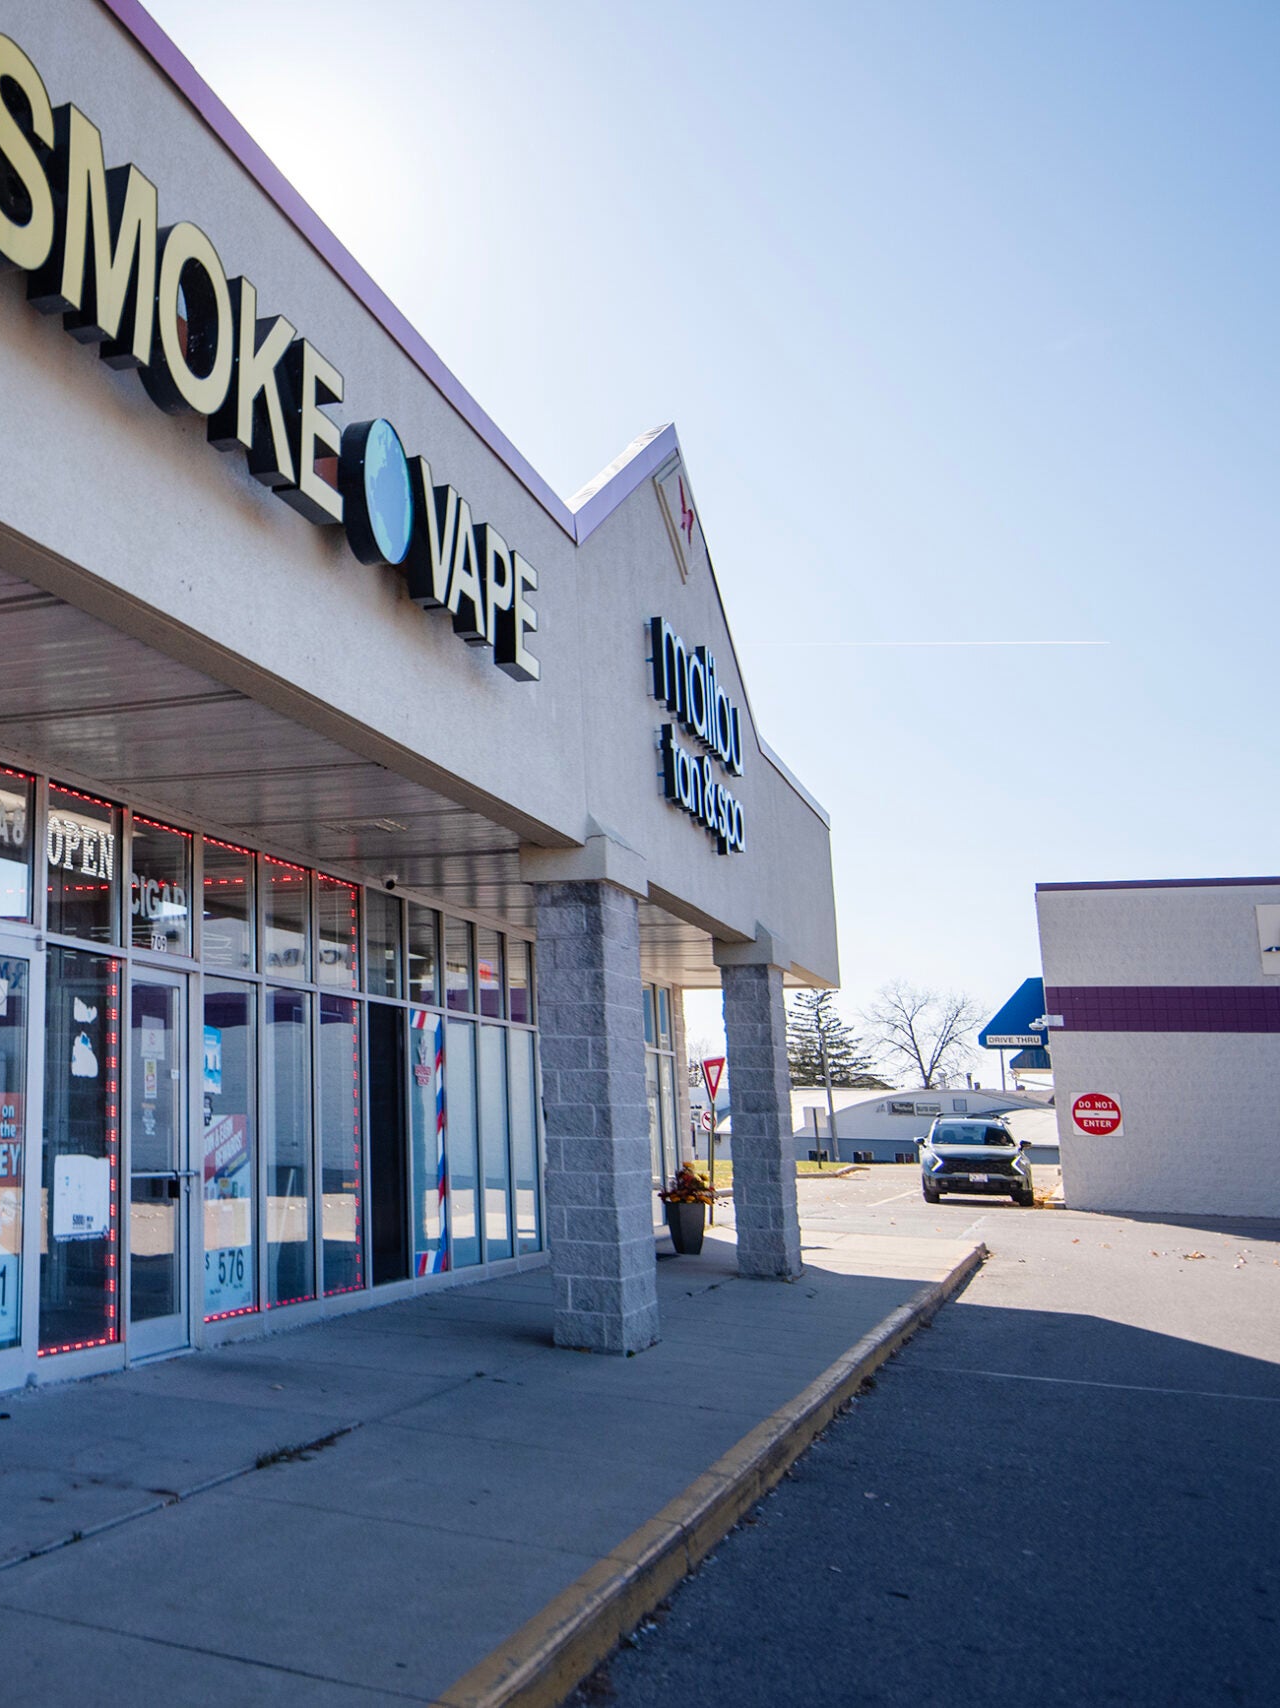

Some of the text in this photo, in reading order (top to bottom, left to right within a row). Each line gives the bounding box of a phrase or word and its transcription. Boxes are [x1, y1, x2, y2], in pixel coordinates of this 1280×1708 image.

[410, 455, 540, 682] VAPE
[650, 616, 744, 777] malibu
[47, 817, 114, 880] OPEN
[151, 934, 167, 951] 709
[988, 1036, 1040, 1044] DRIVE THRU
[2, 1105, 15, 1118] on
[1, 1121, 17, 1138] the
